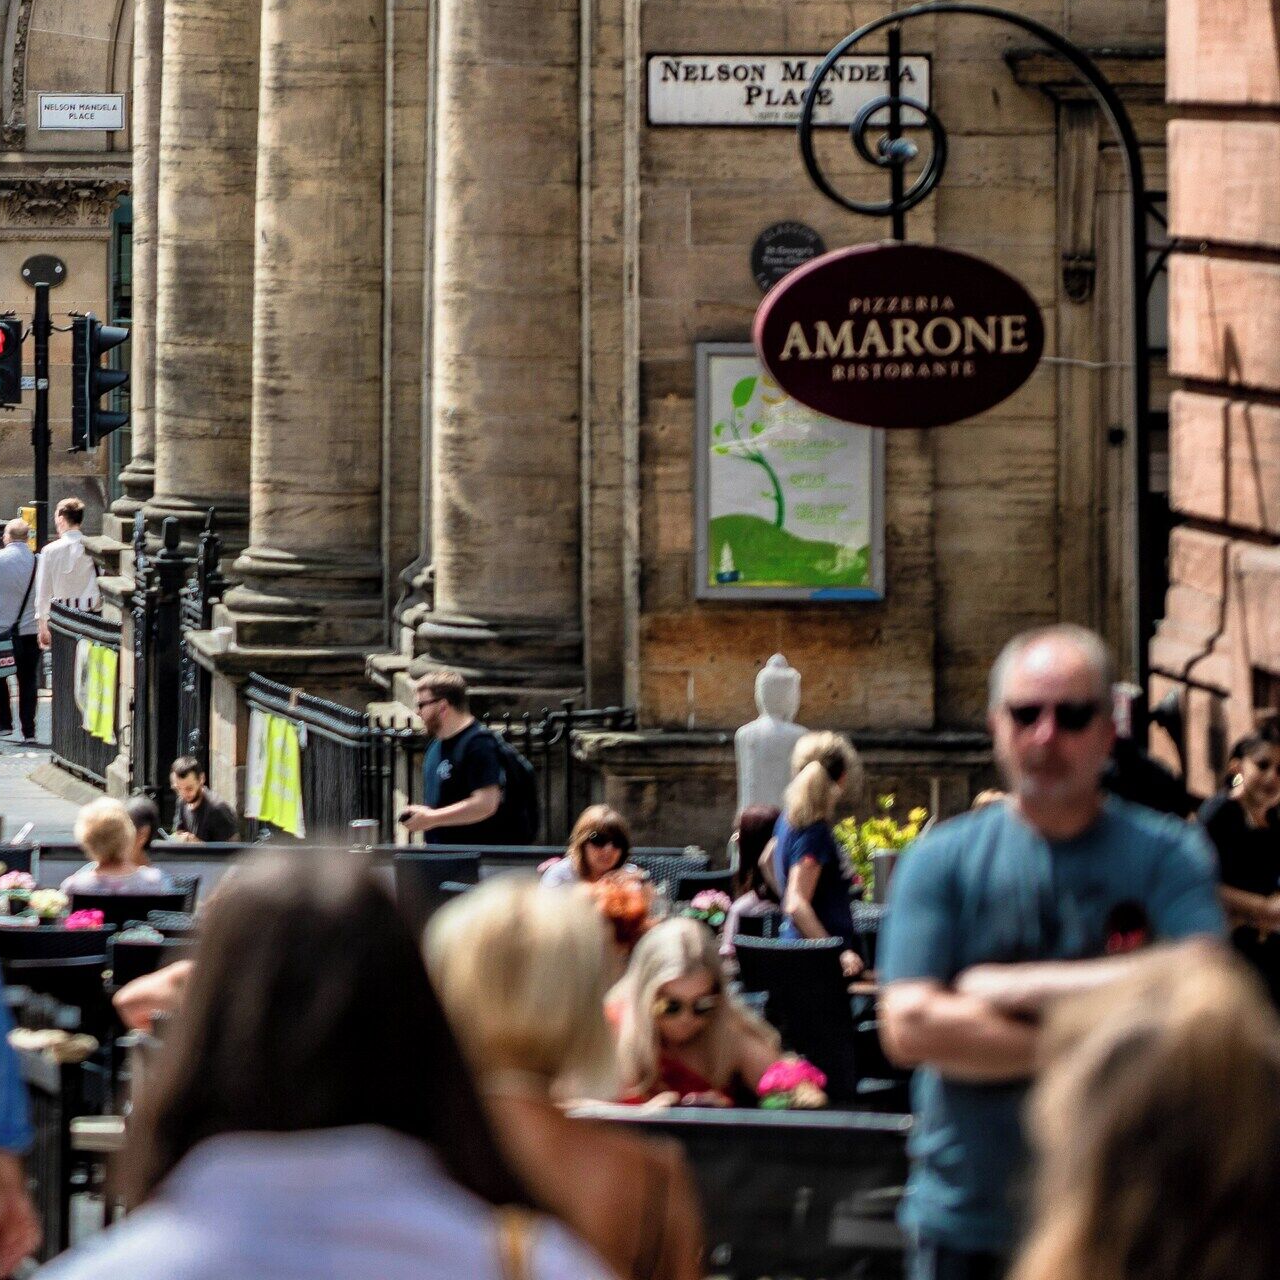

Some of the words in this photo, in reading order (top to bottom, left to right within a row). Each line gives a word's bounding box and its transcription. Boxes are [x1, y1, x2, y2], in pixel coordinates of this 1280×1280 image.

[659, 60, 766, 83] NELSON
[780, 60, 915, 83] MNDEA
[44, 103, 76, 111] NELSON
[78, 103, 118, 111] MANDELA
[68, 112, 96, 120] PLACE
[848, 295, 955, 314] PIZZERIA
[778, 314, 1028, 361] AMARONE
[831, 360, 976, 382] RISTORANTE
